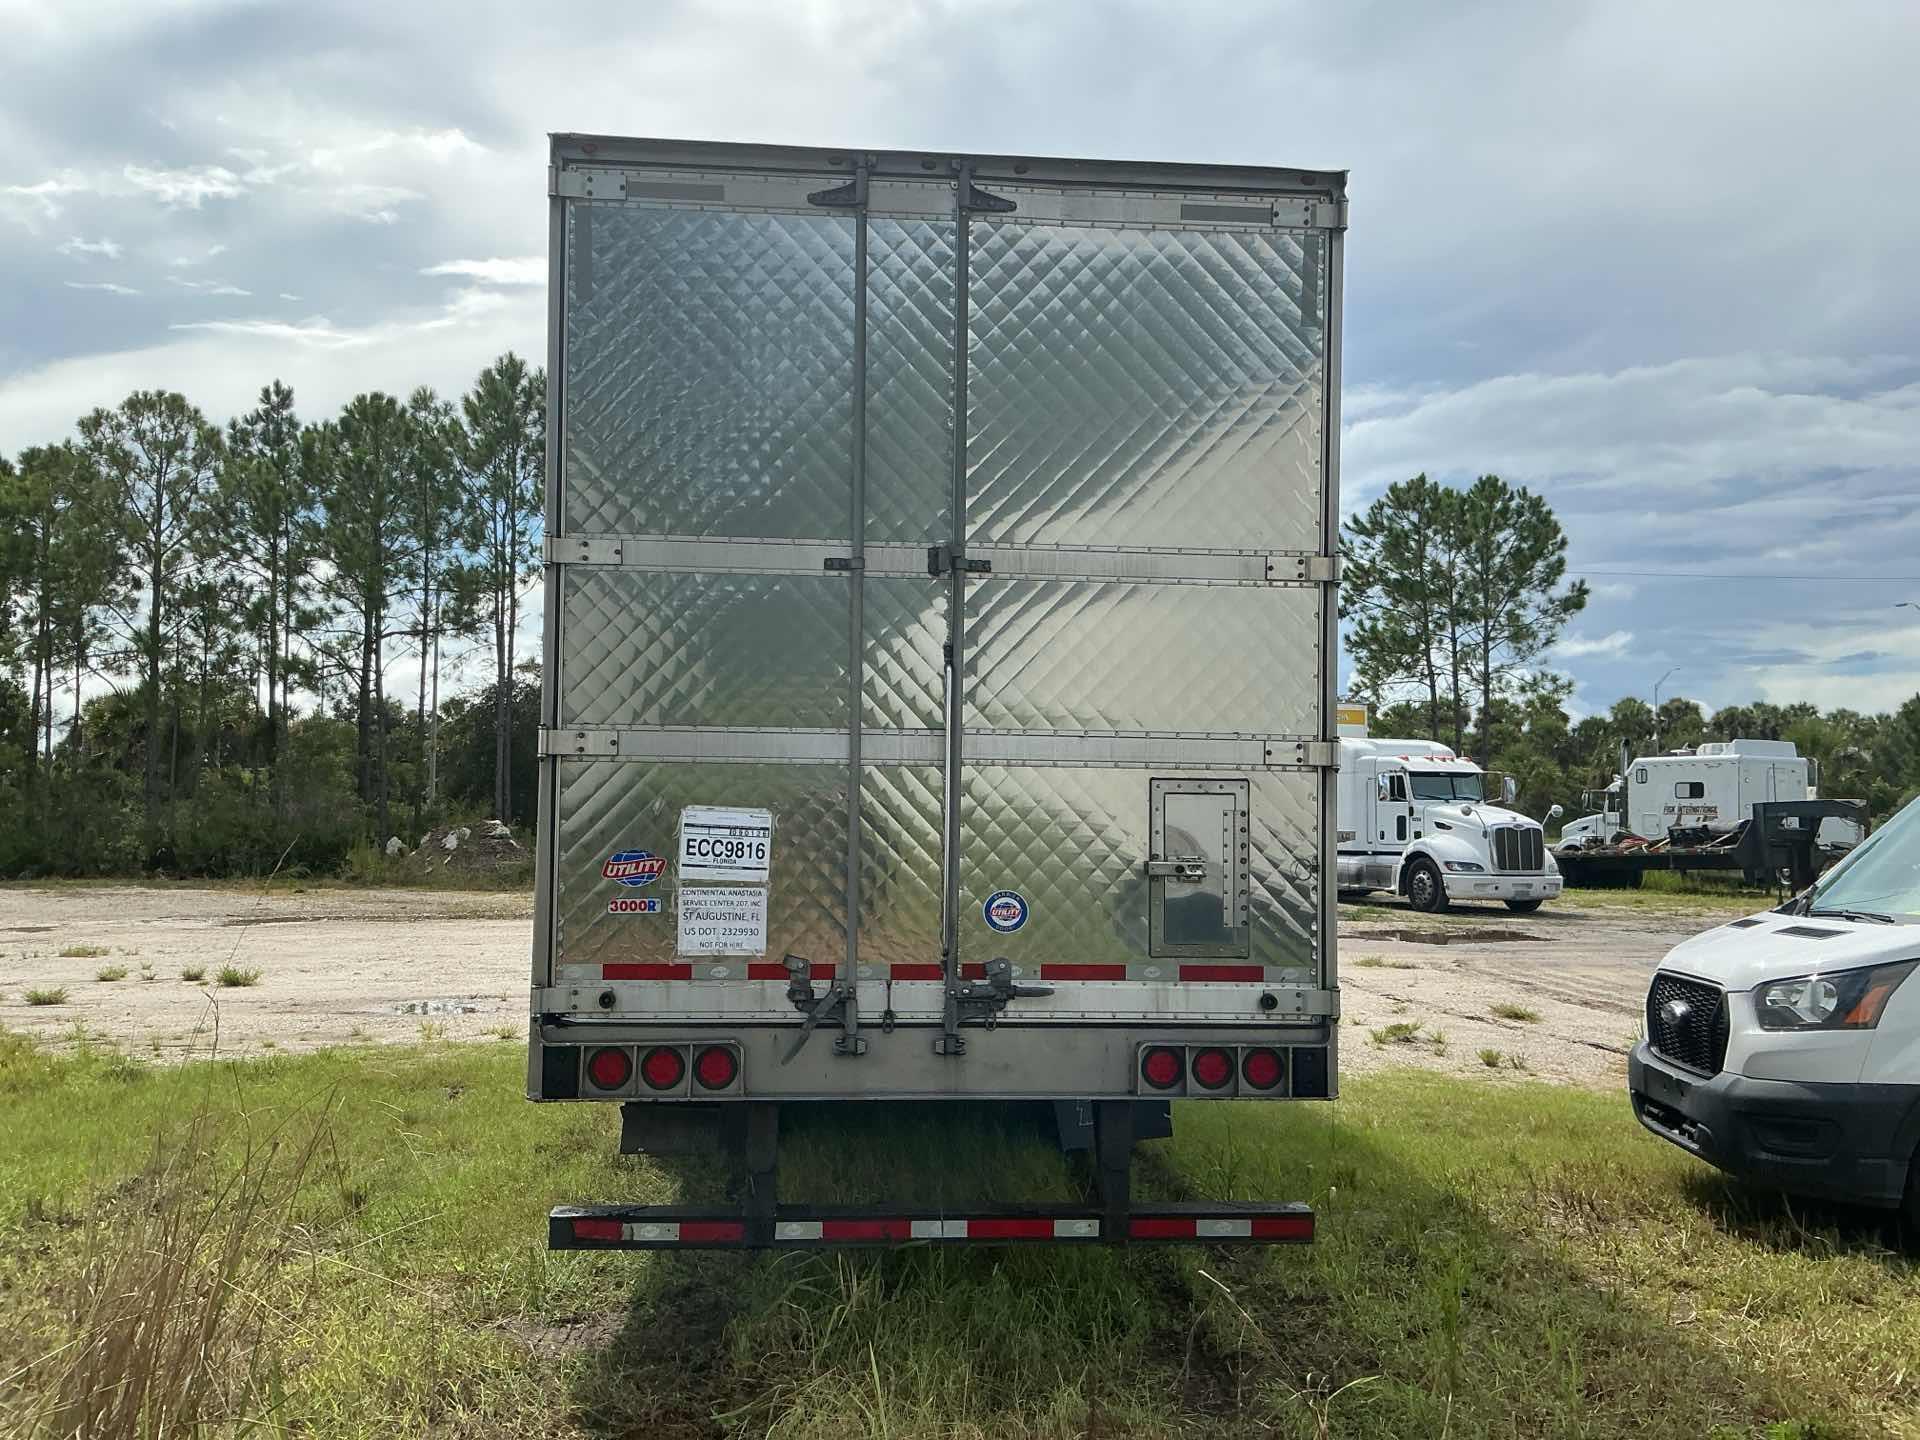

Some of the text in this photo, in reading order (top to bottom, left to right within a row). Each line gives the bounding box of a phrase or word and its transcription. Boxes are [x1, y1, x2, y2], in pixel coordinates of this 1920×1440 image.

[686, 838, 766, 860] ECC9816
[606, 860, 663, 876] UTILITY
[681, 889, 762, 897] CONTINENTAL ANASTASIA
[610, 900, 657, 912] 3000R
[683, 911, 694, 921] ST
[751, 912, 760, 921] FL
[684, 927, 696, 936] US
[722, 927, 760, 936] 2329930
